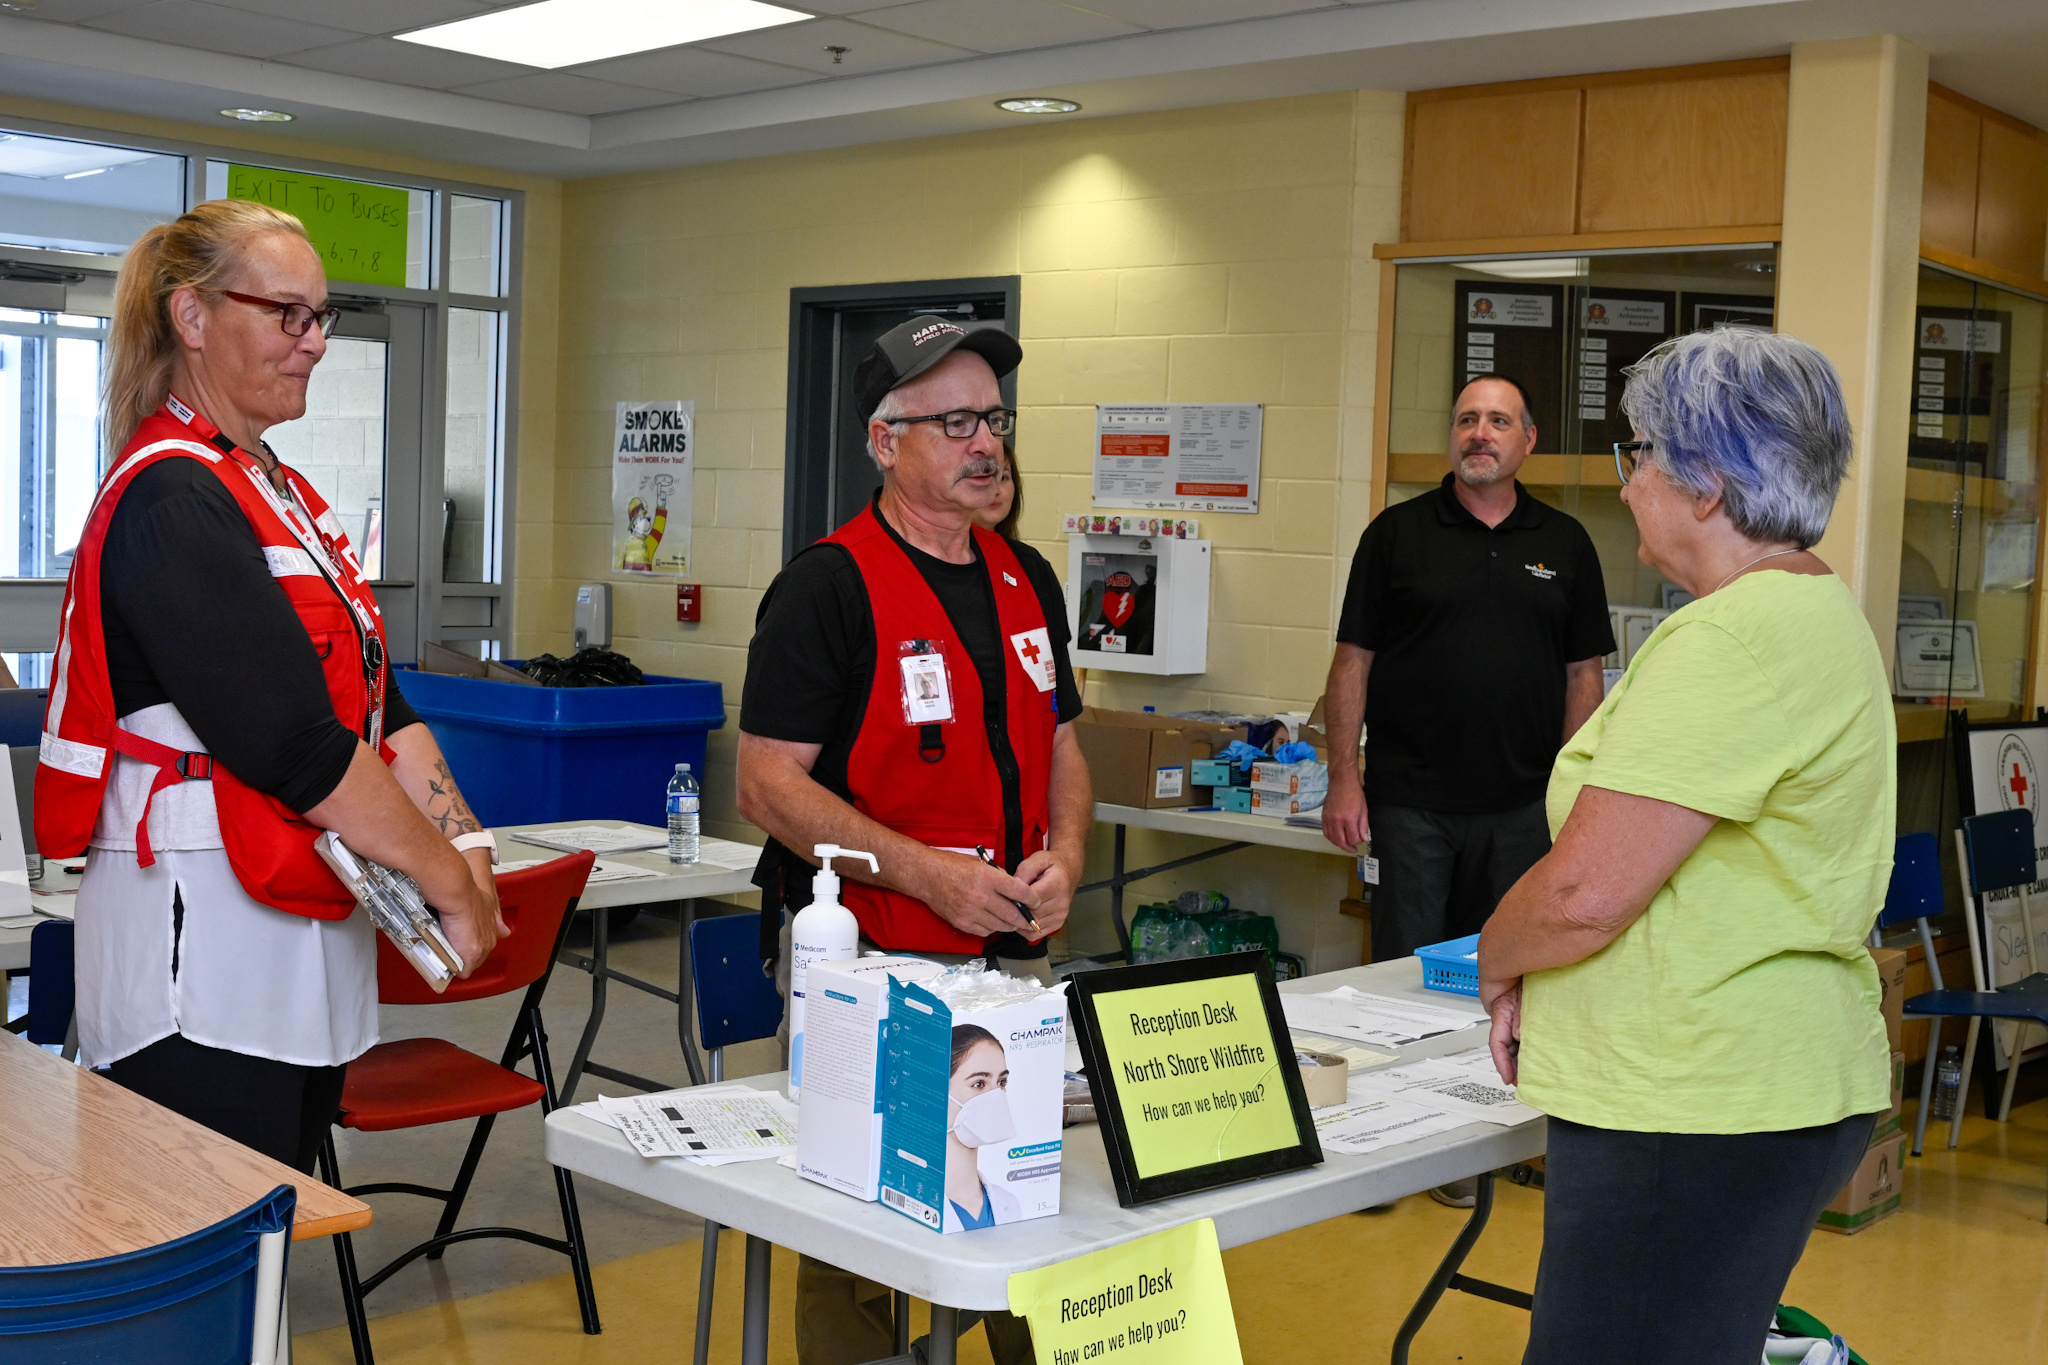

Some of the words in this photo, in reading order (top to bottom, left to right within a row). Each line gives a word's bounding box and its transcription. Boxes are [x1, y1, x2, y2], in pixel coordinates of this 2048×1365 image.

[234, 174, 298, 207] EXIT
[309, 186, 335, 213] TO
[349, 192, 400, 227] BUSES
[625, 410, 684, 430] SMOKE
[619, 433, 686, 453] ALARMS
[1106, 574, 1131, 587] AED
[1130, 1008, 1200, 1036] Reception
[1202, 1001, 1238, 1025] Desk
[1010, 1025, 1063, 1041] CHAMPAK
[1010, 1043, 1022, 1051] N95
[1026, 1037, 1063, 1048] RESPIRATOR
[1123, 1057, 1166, 1084] North
[1168, 1052, 1209, 1077] Shore
[1210, 1044, 1265, 1069] Wildfire
[1142, 1102, 1169, 1122] How
[1172, 1100, 1193, 1117] can
[1195, 1098, 1211, 1112] we
[1212, 1090, 1238, 1110] help
[1240, 1083, 1265, 1108] you?
[1040, 1165, 1060, 1174] Approved
[1038, 1202, 1046, 1211] 15
[1061, 1284, 1134, 1323] Reception
[1138, 1267, 1173, 1299] Desk
[1054, 1347, 1079, 1365] How
[1083, 1340, 1104, 1360] can
[1108, 1333, 1125, 1351] we
[1128, 1321, 1153, 1345] help
[1157, 1309, 1186, 1339] you?
